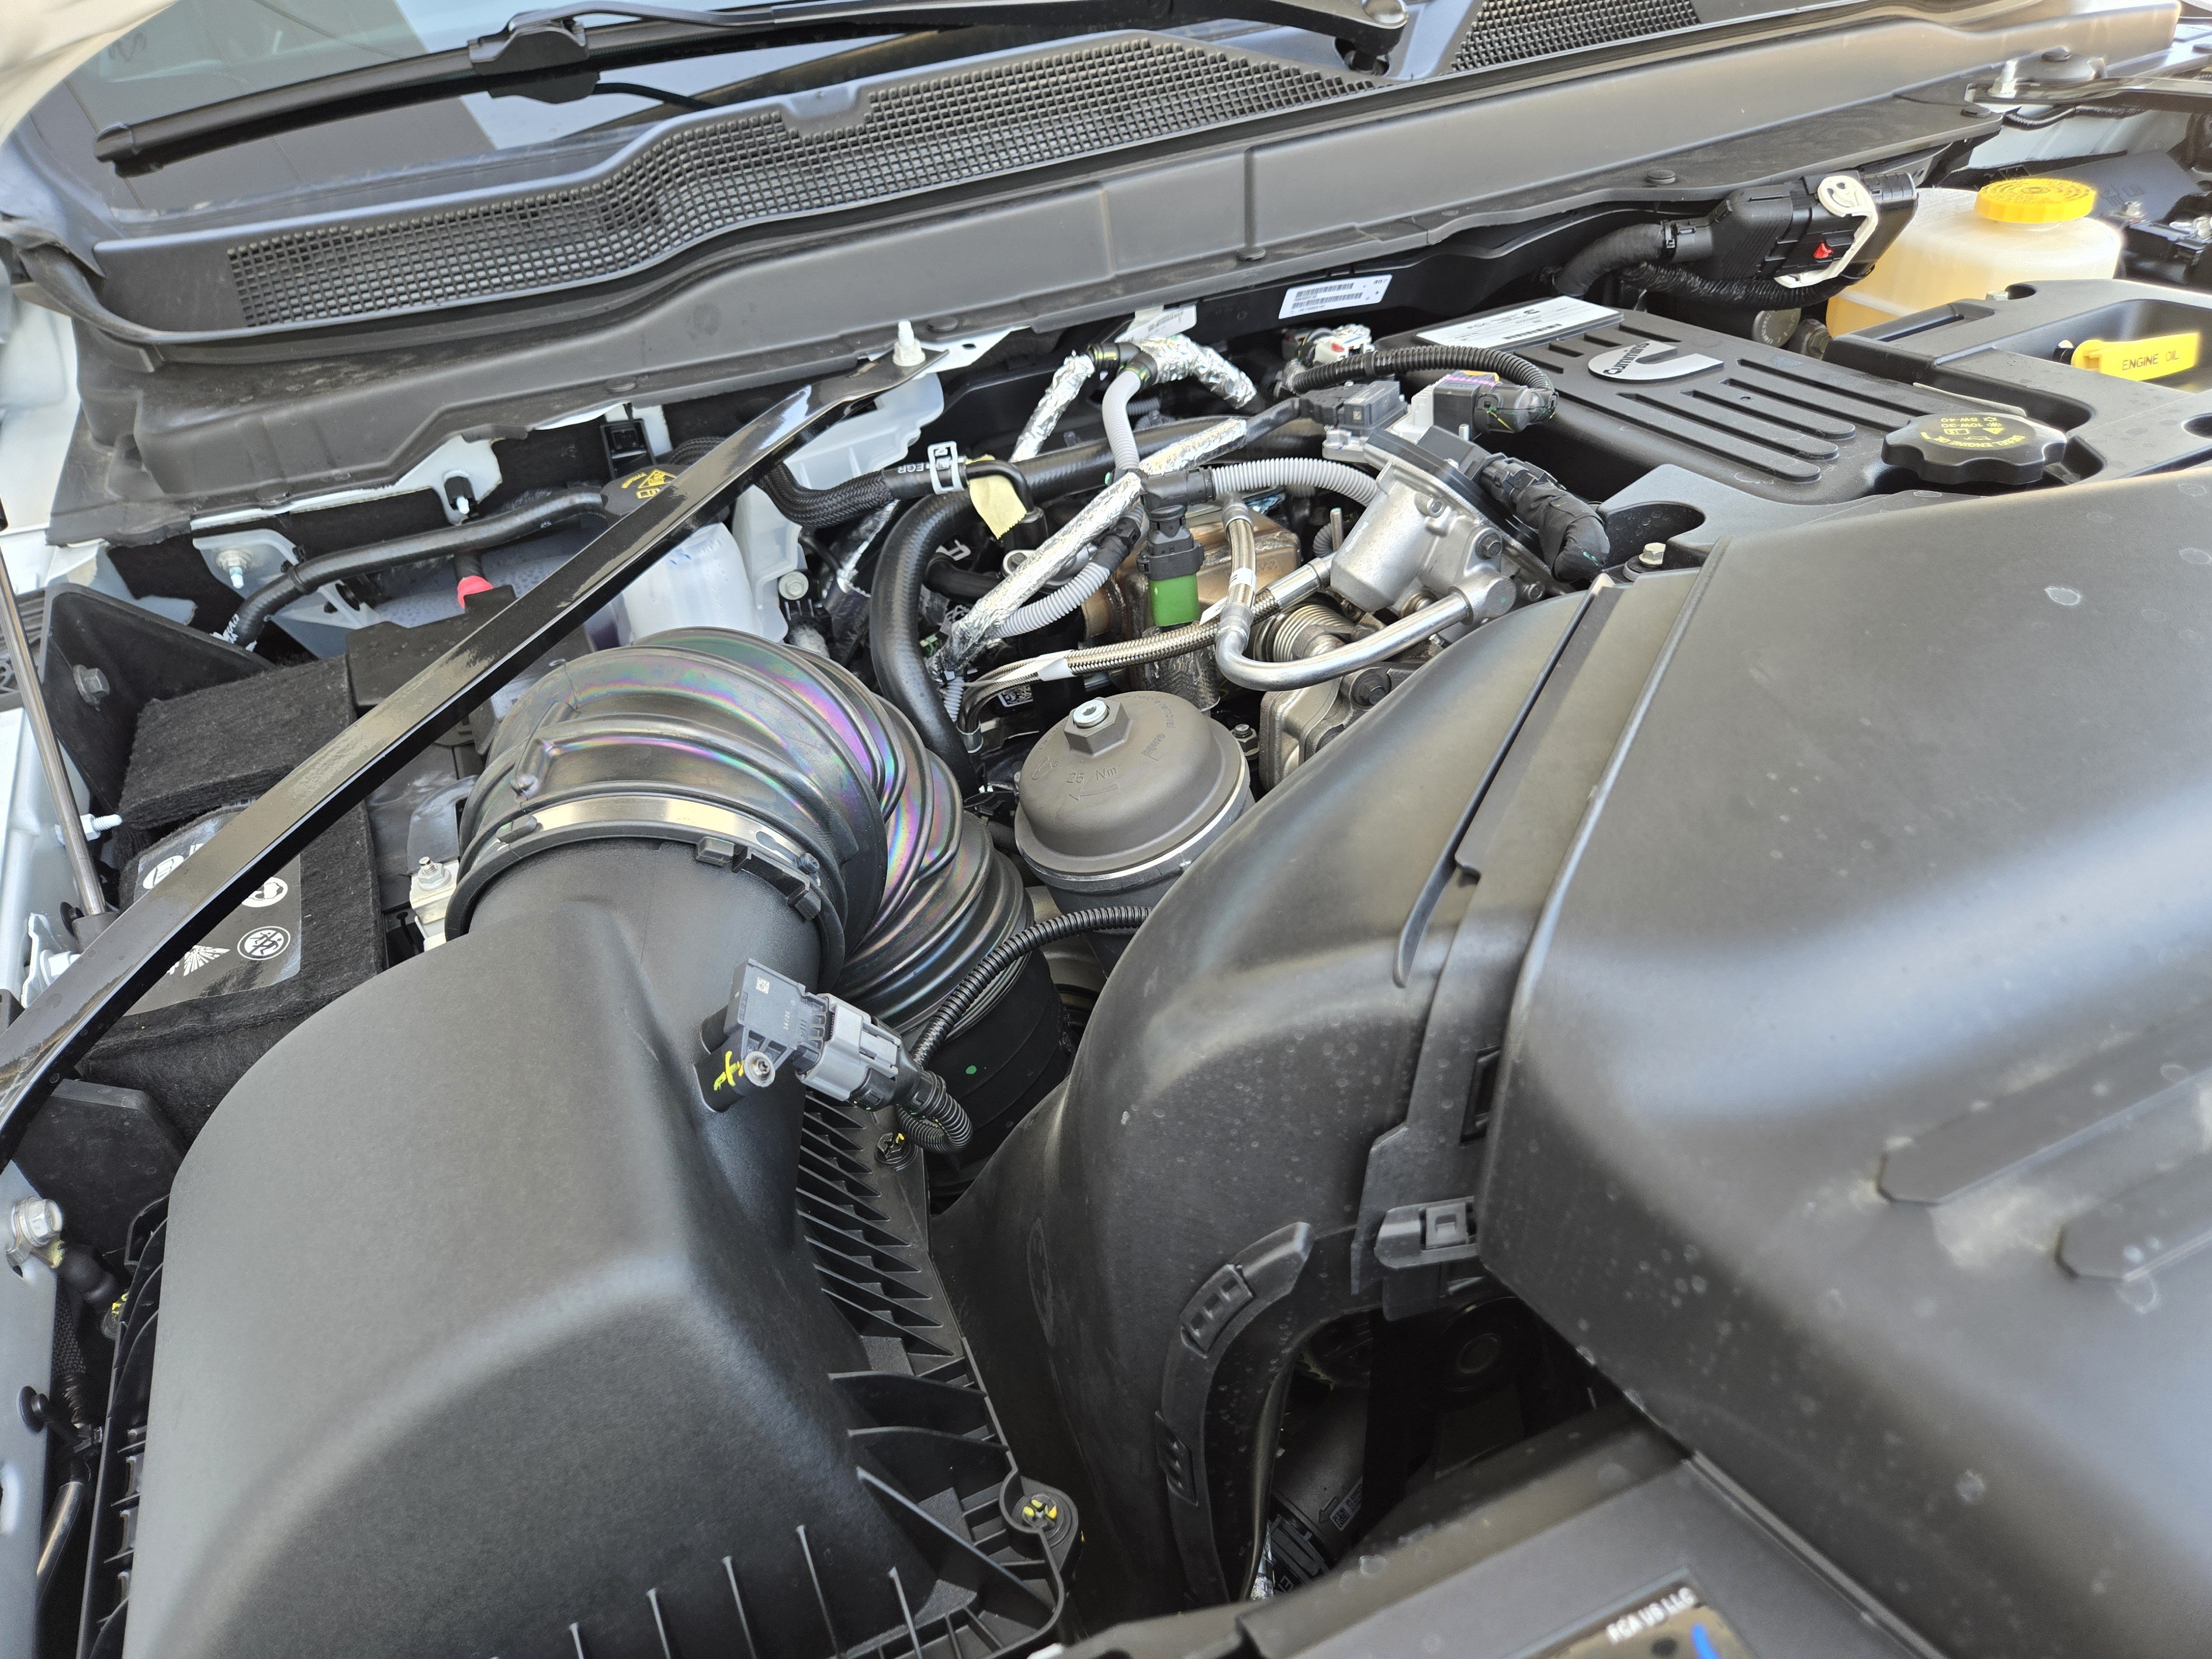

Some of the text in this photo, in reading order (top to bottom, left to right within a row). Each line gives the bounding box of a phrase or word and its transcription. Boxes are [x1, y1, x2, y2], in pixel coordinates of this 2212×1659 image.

[2122, 349, 2179, 371] ENGINE OIL
[1948, 440, 1993, 448] ENGINE
[897, 462, 924, 474] EGR
[1095, 766, 1117, 781] Nm
[1606, 1614, 1642, 1645] FCA
